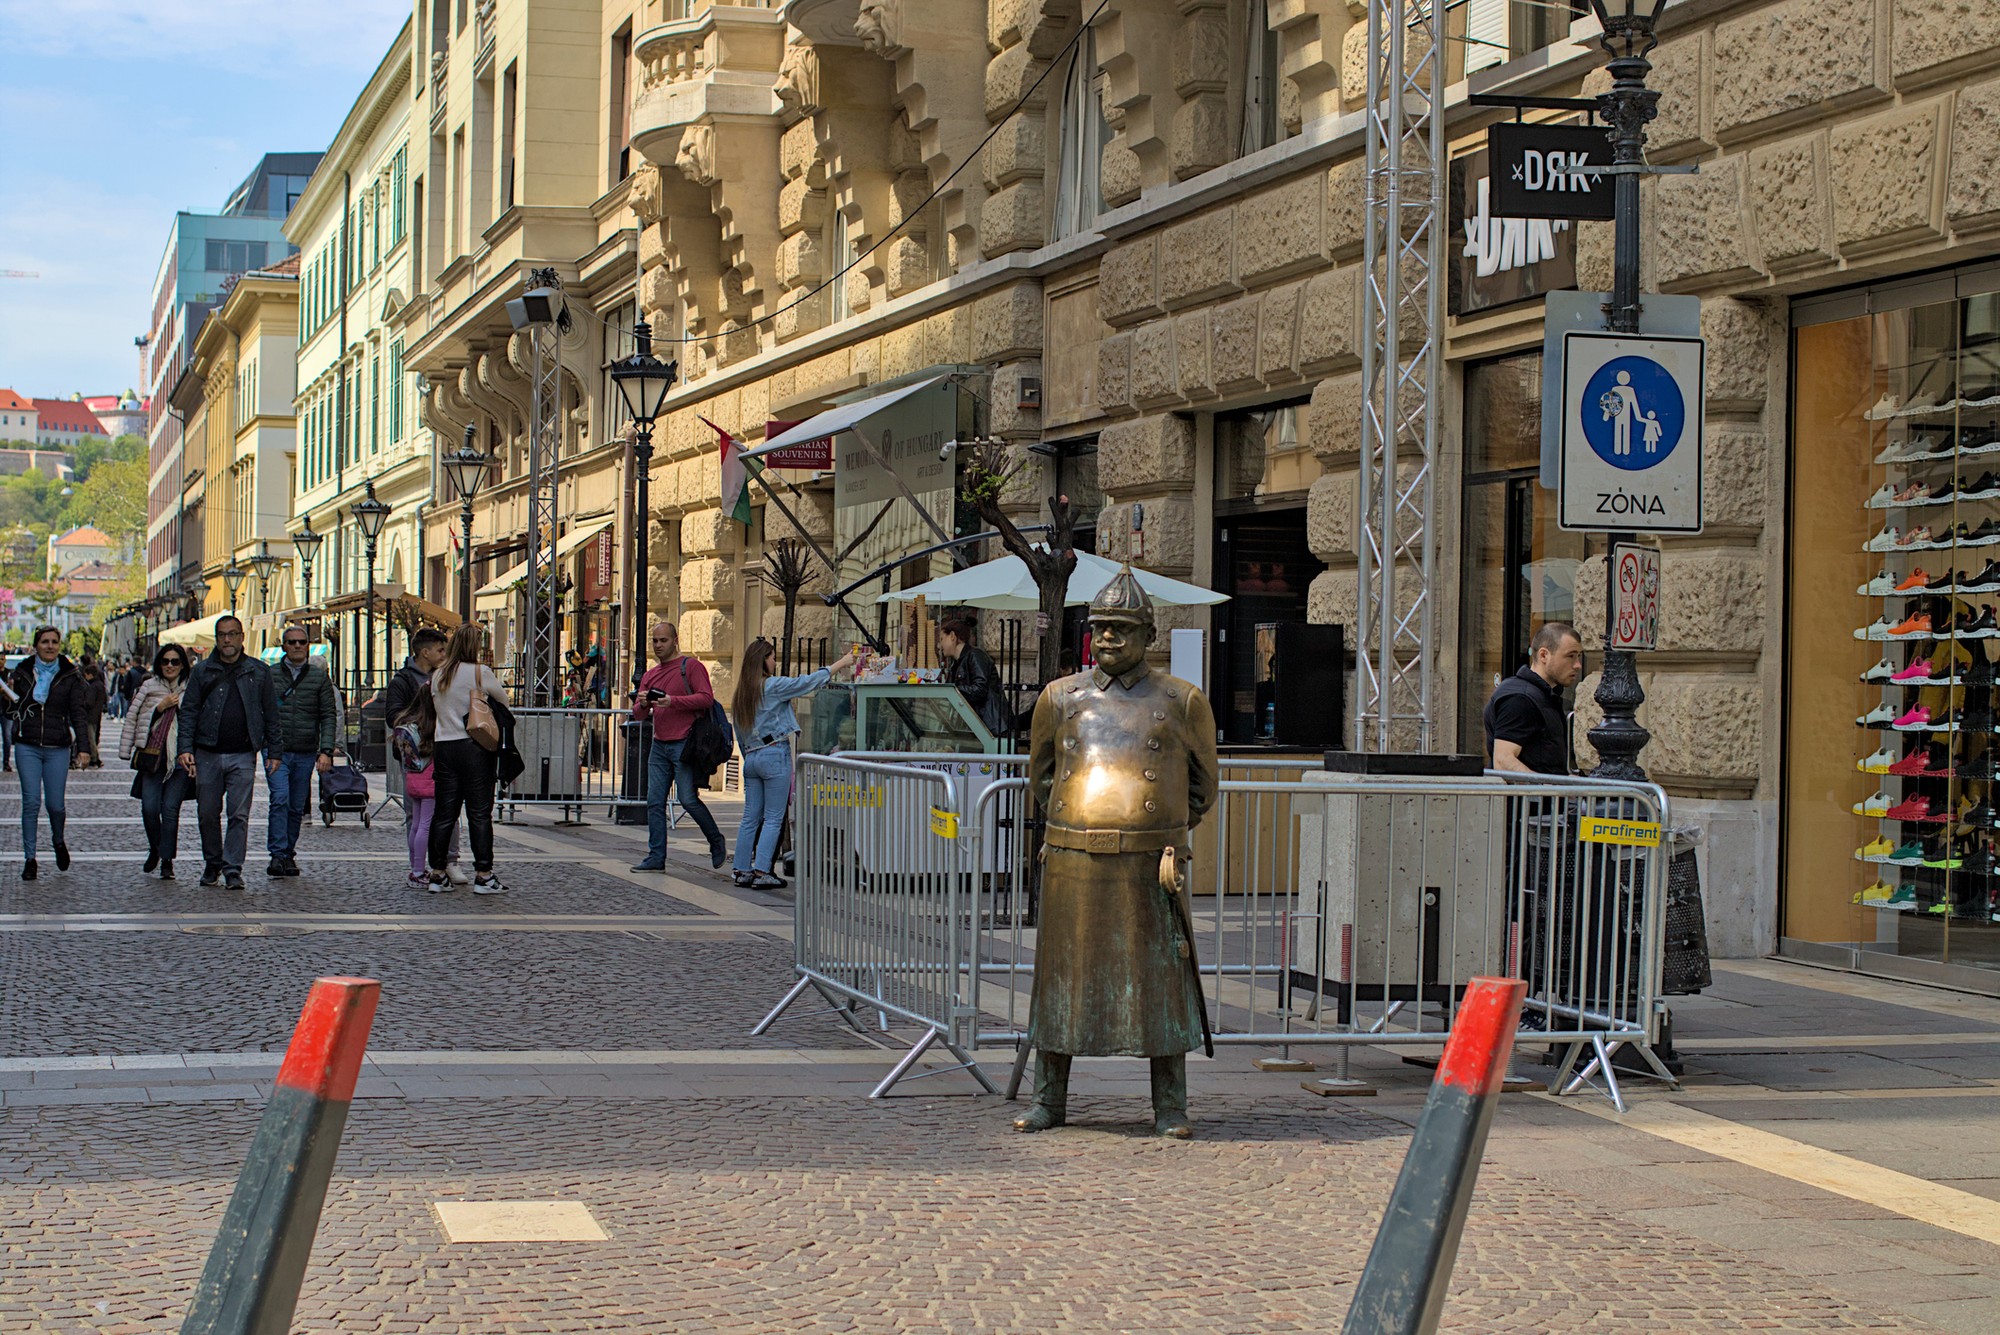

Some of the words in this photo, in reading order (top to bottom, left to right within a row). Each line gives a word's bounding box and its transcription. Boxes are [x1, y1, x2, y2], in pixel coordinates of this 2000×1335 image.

[772, 450, 827, 459] SOUVENIRS
[845, 446, 876, 472] MEMORIE
[894, 441, 905, 460] OF
[906, 430, 944, 457] HUNGARY
[1596, 486, 1666, 515] ZÓNA
[1593, 824, 1658, 838] profirent
